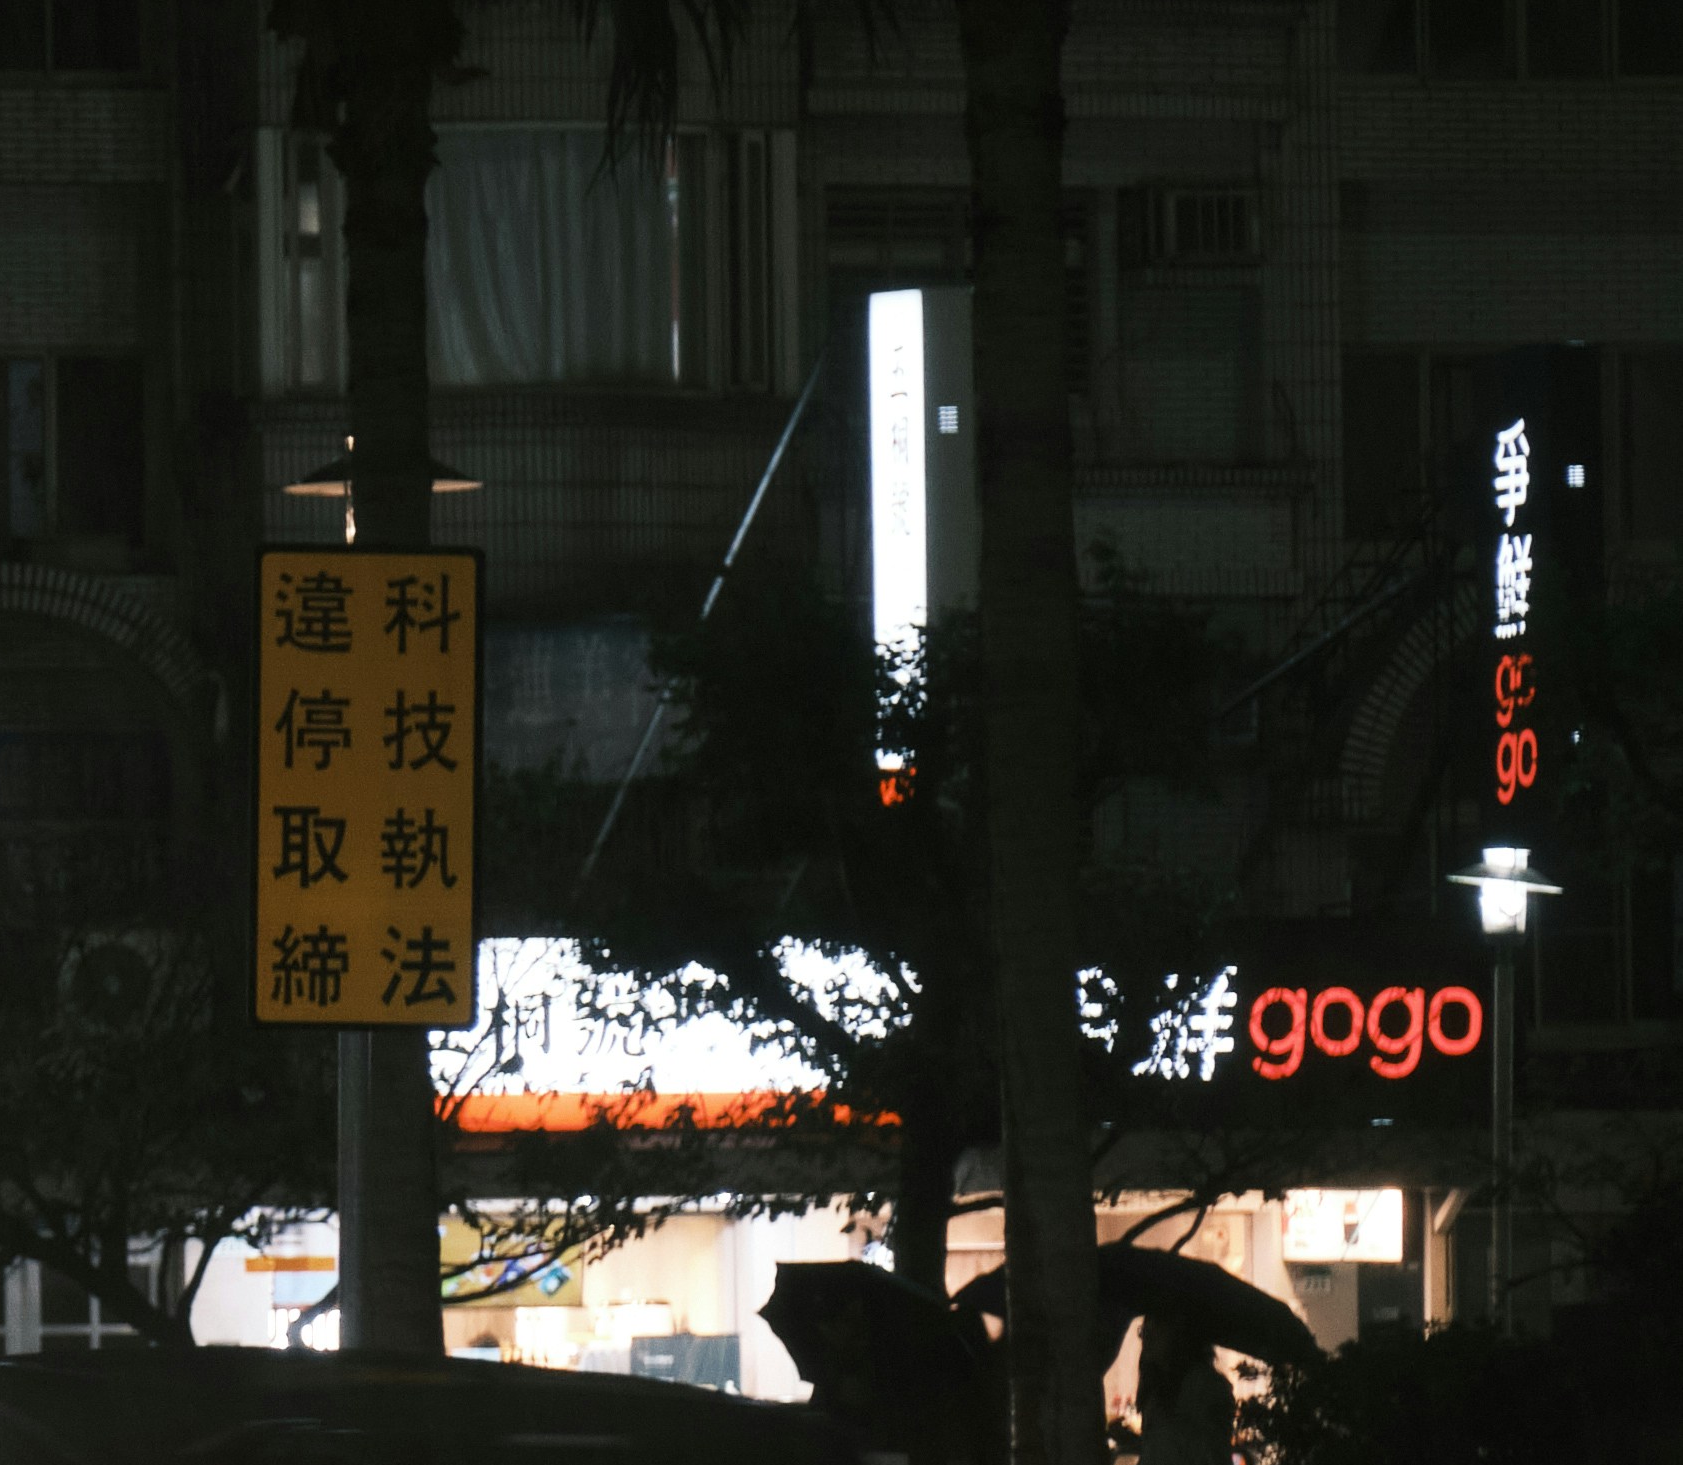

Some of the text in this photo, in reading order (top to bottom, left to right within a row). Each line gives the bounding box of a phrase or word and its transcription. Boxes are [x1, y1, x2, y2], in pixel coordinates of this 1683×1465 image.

[1492, 418, 1535, 640] 爭鮮
[271, 570, 354, 1010] 違停取締
[381, 570, 462, 1010] 科技執法
[1248, 984, 1485, 1082] gogo
